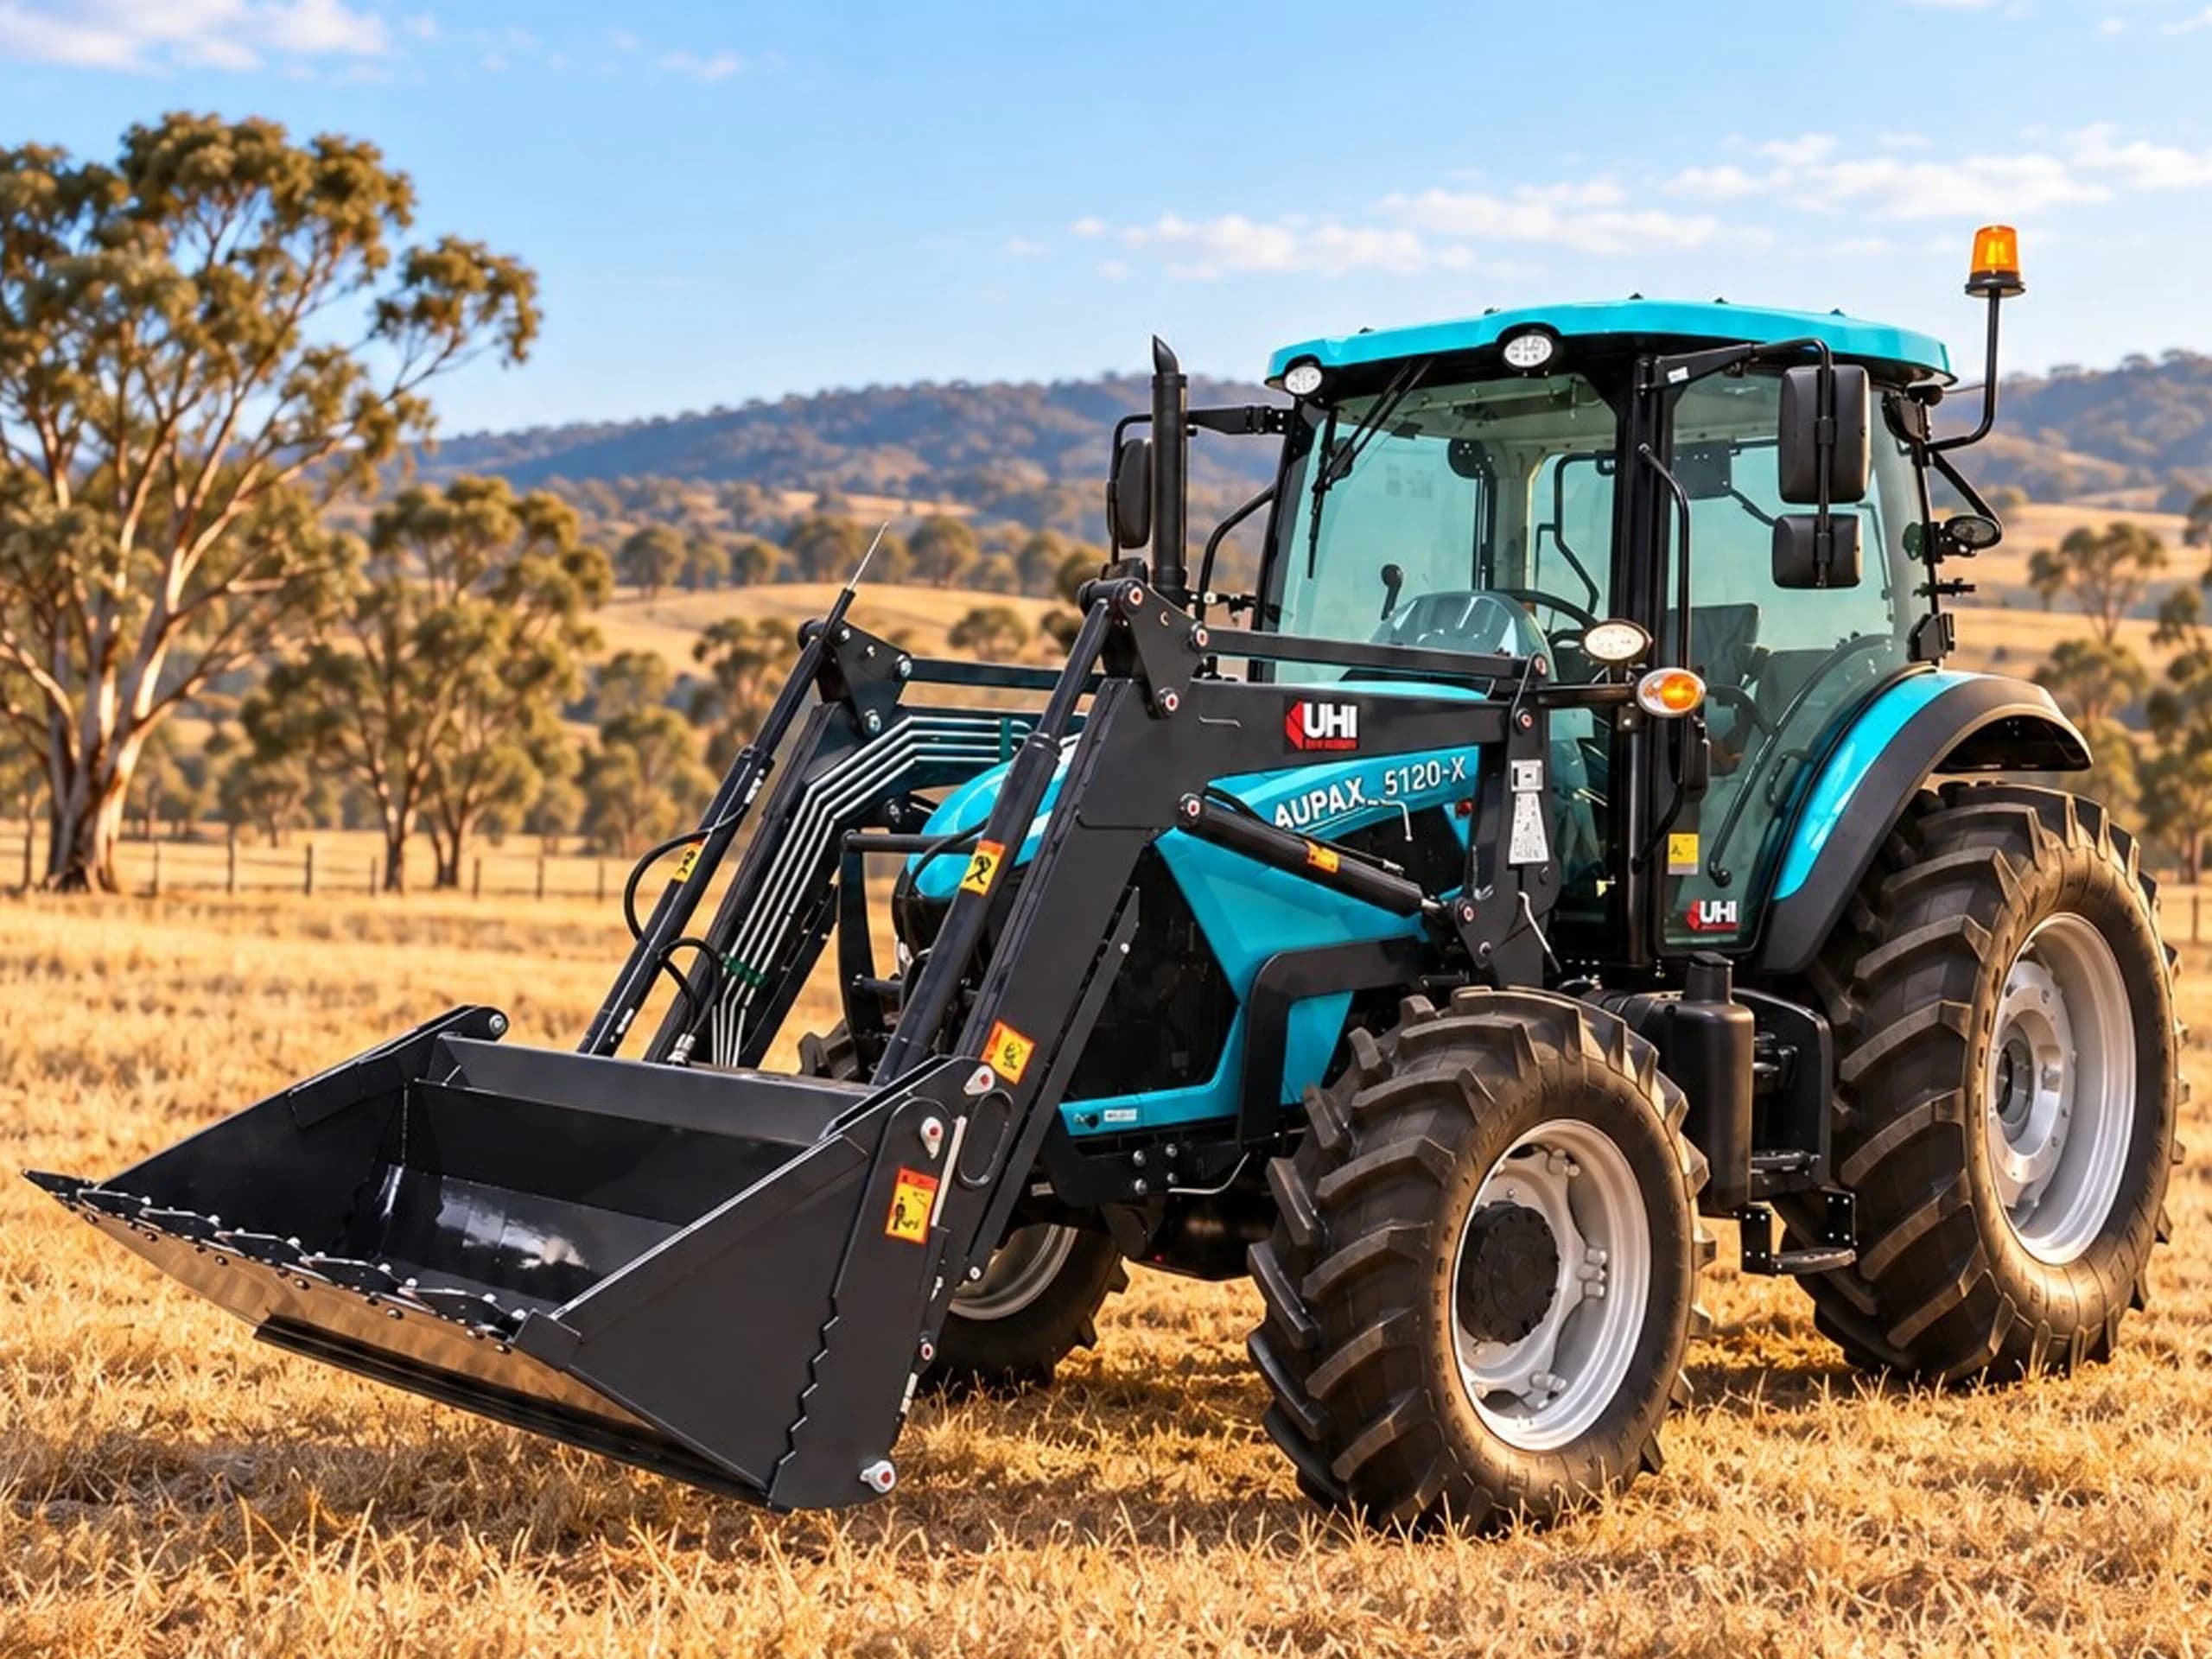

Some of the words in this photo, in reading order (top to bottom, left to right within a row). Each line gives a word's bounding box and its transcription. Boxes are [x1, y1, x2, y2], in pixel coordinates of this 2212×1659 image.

[1303, 702, 1357, 739] UHI
[1274, 777, 1366, 830] AUPAX
[1384, 756, 1466, 796] 5120-X
[1700, 900, 1737, 924] UHI
